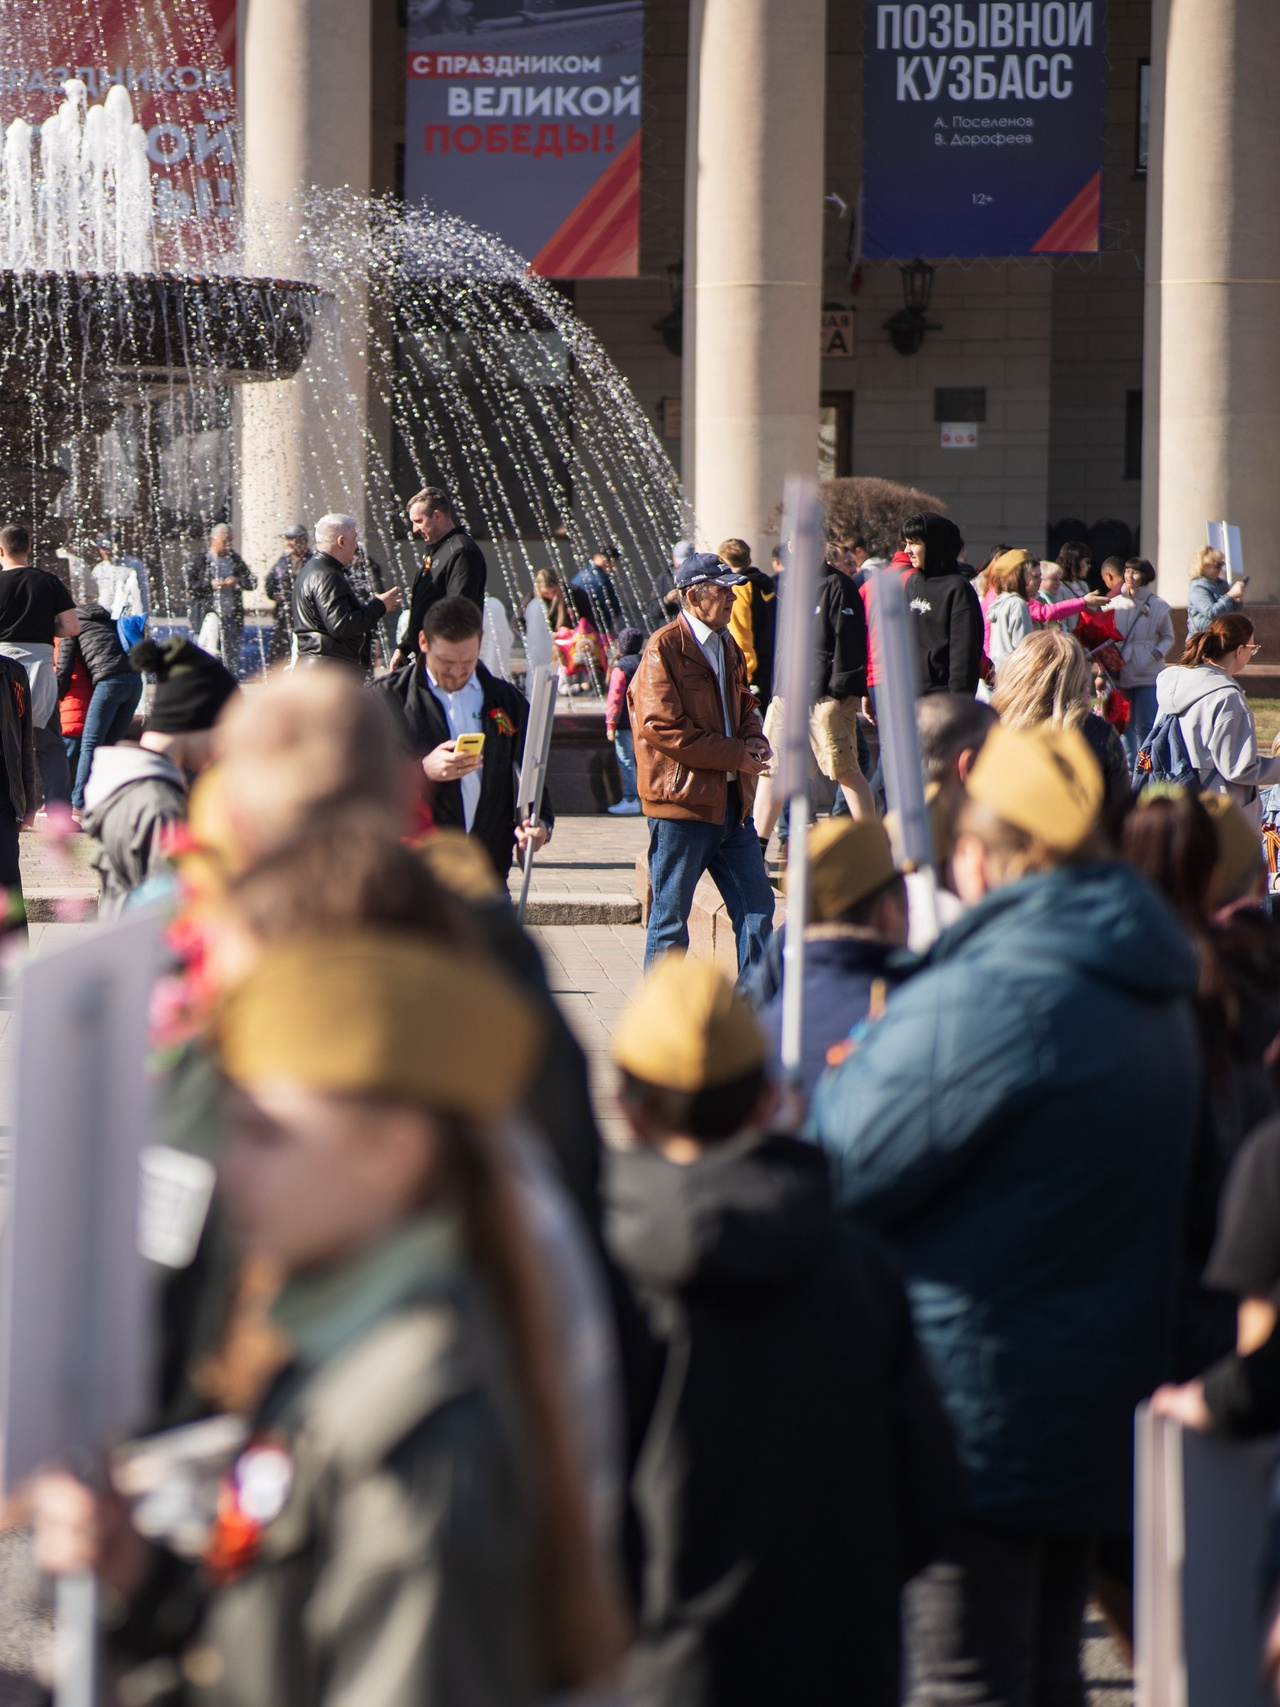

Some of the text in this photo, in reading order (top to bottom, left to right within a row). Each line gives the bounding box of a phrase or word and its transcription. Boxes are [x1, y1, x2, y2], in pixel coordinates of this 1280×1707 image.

[412, 55, 602, 77] С ПРАЗДНИКОМ
[895, 53, 1074, 101] КУЗБАСС
[447, 75, 641, 117] ВЕЛИКОЙ
[933, 115, 1034, 128] А. Поселенов
[424, 124, 615, 159] ПОБЕДЫ!
[934, 132, 1033, 147] В. Дорофеев
[971, 193, 994, 205] 12+
